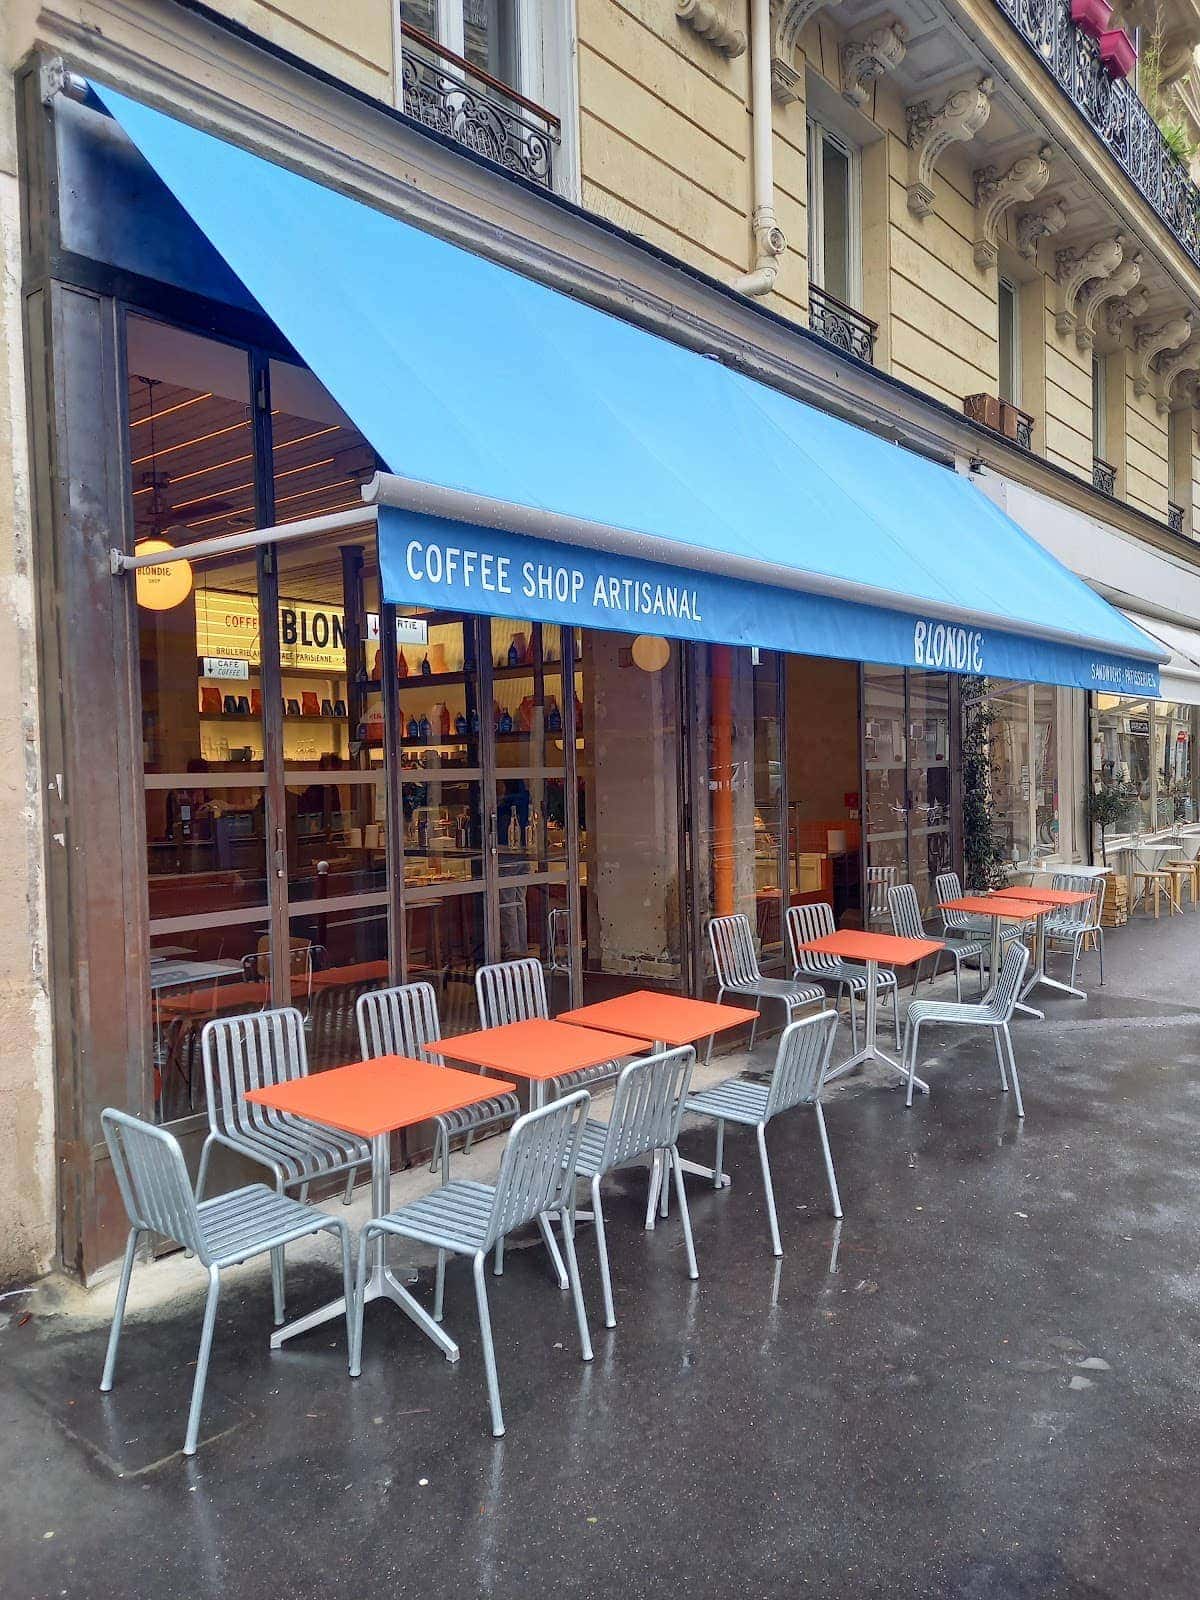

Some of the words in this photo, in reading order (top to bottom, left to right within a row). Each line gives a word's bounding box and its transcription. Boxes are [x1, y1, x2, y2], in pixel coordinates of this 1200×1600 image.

[137, 567, 172, 577] BLONDIE
[406, 541, 512, 594] COFFEE
[522, 562, 585, 603] SHOP
[593, 575, 703, 622] ARTISANAL
[225, 615, 258, 630] COFFE
[281, 609, 347, 650] BLON
[397, 619, 417, 630] RTIE
[914, 621, 984, 673] BLONDIE
[296, 654, 332, 664] PARISIENNE
